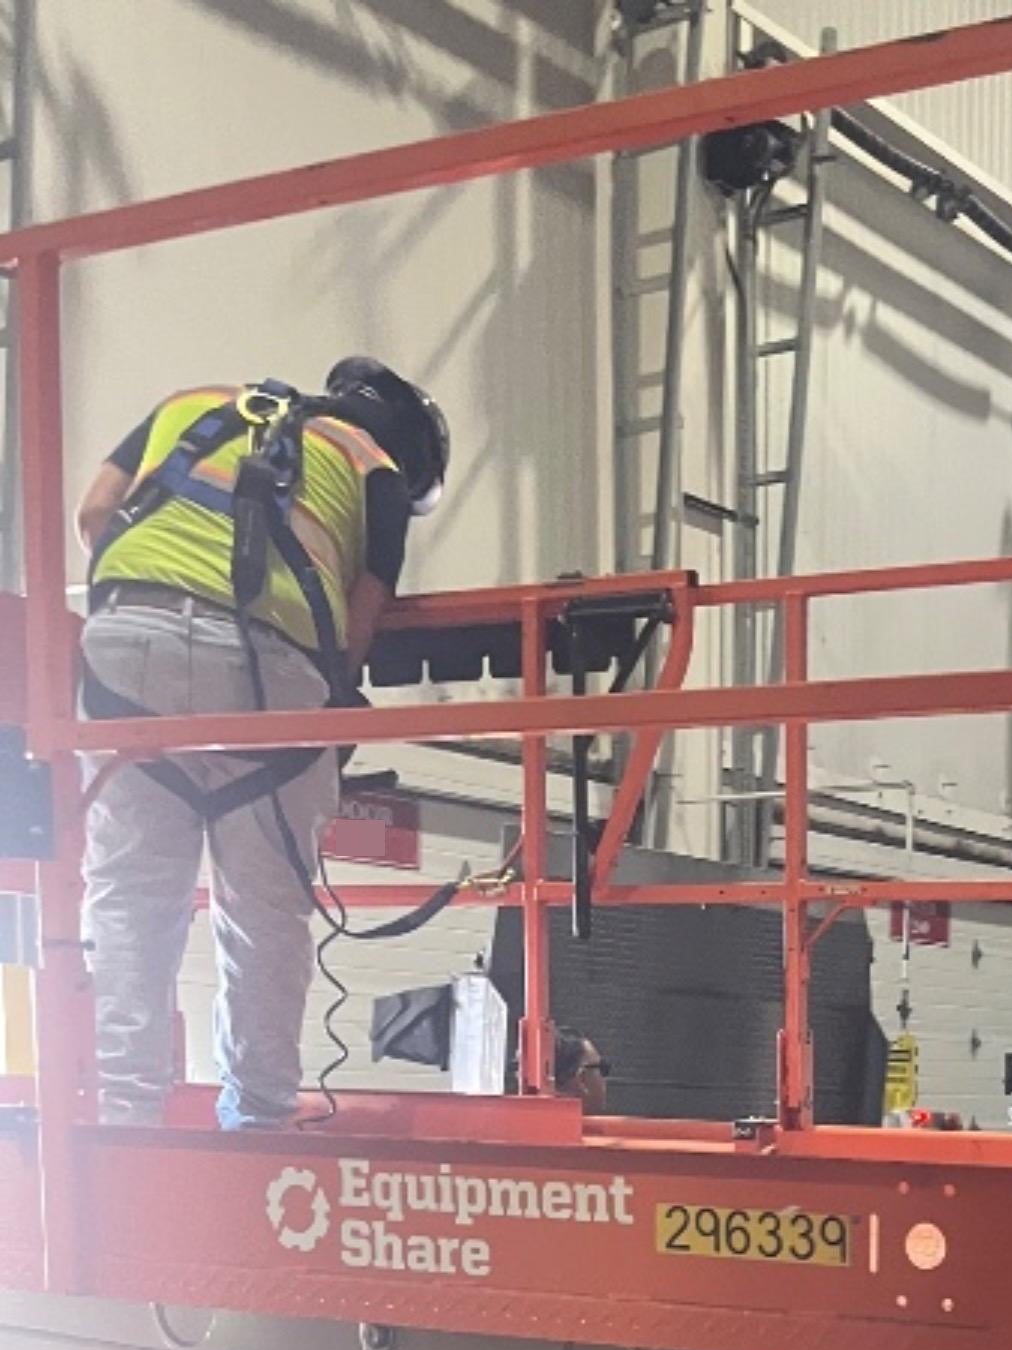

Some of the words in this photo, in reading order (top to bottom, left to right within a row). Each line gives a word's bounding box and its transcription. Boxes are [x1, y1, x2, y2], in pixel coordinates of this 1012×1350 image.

[338, 1158, 634, 1224] Equipment
[340, 1220, 491, 1277] Share
[663, 1204, 849, 1264] 296339
